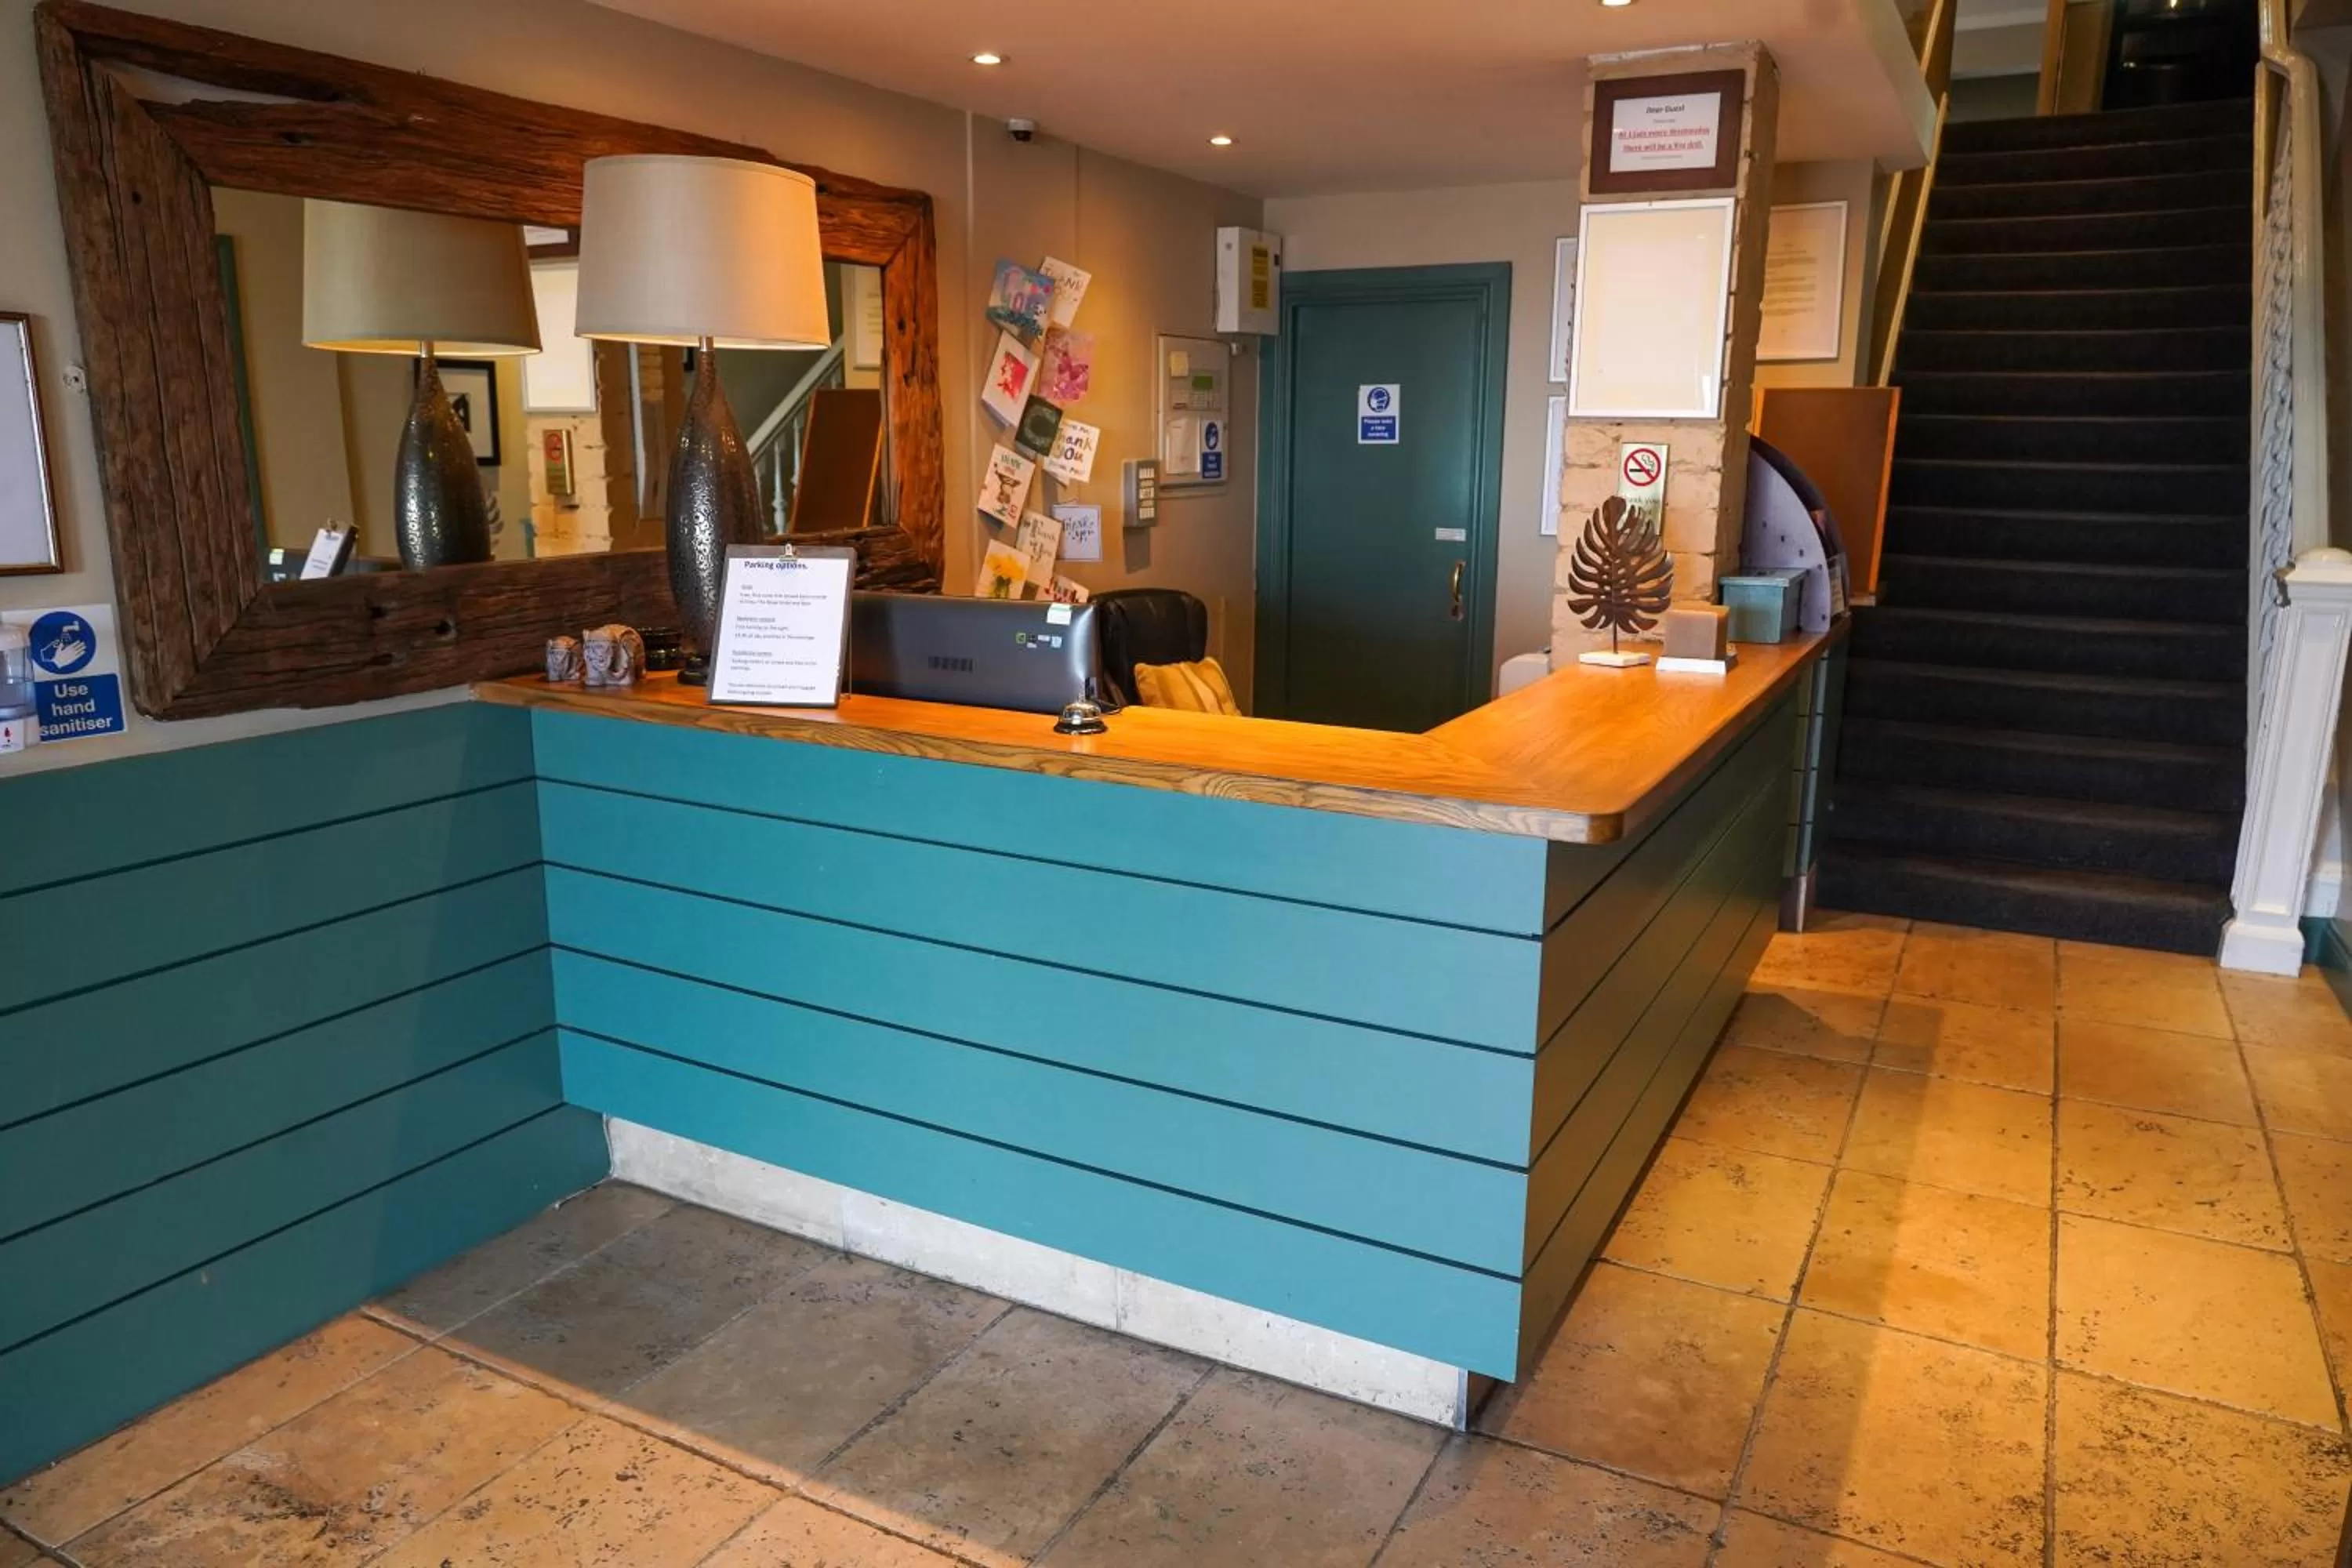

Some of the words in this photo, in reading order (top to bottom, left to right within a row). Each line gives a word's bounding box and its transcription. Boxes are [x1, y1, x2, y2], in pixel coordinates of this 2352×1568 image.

[744, 561, 774, 570] Parking
[775, 561, 808, 571] options.
[54, 684, 89, 698] Use
[52, 699, 96, 716] hand
[40, 717, 113, 736] sanitiser
